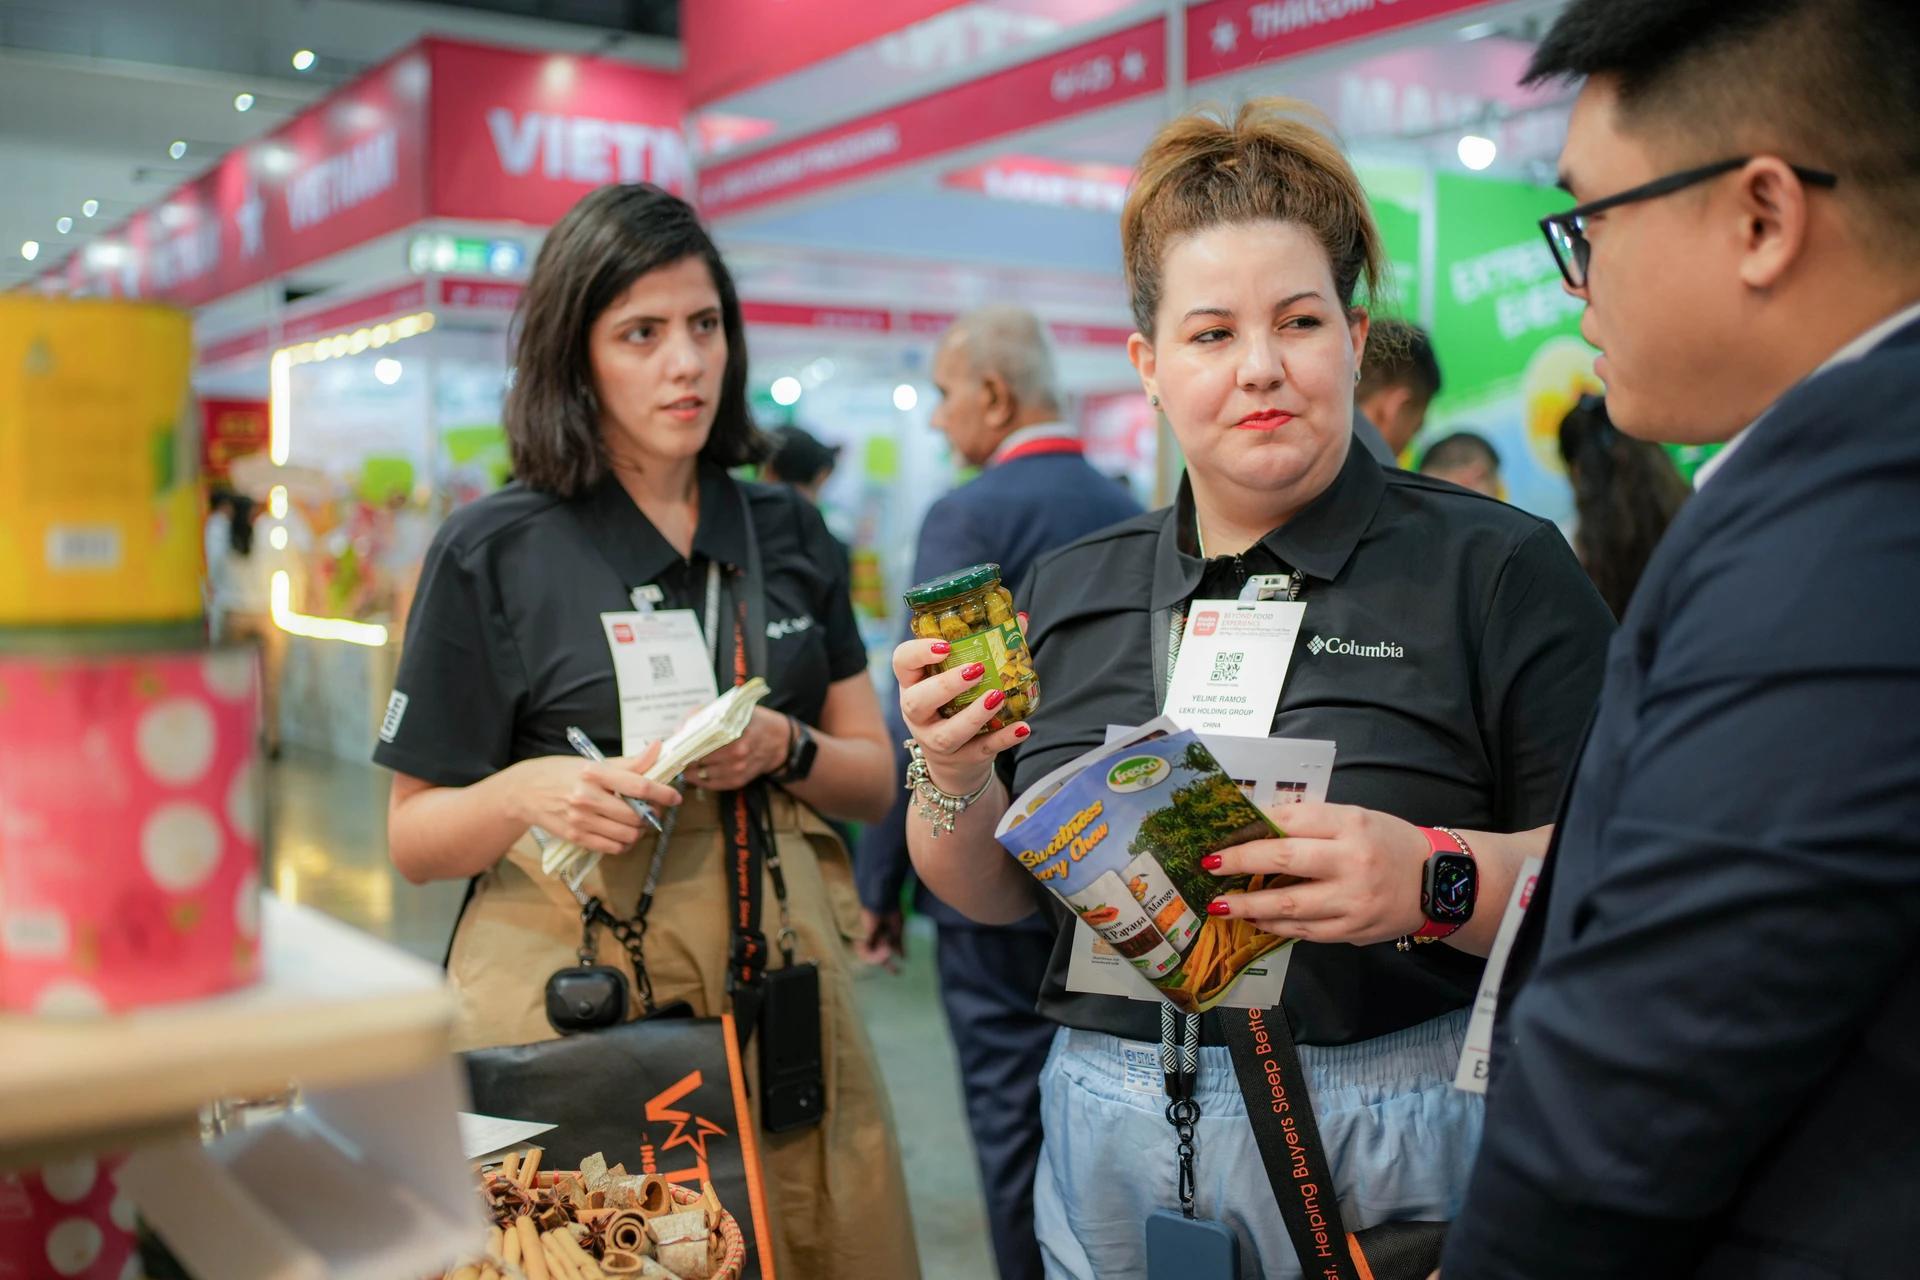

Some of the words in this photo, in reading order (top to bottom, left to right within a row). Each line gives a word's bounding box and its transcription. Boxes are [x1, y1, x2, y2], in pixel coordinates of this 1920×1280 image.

[1325, 637, 1404, 658] Columbia
[1192, 694, 1217, 702] YELINE
[1219, 695, 1247, 704] RAMOS
[1179, 706, 1196, 714] LEKE
[1197, 707, 1227, 716] HOLDING
[1228, 708, 1254, 716] GROUP
[1203, 721, 1221, 729] CHINA
[1147, 889, 1174, 914] Mango
[1110, 917, 1147, 940] Papaya
[1249, 1007, 1272, 1055] Bette
[1136, 1052, 1157, 1066] STYLE
[1264, 1059, 1289, 1113] Sleep
[1281, 1117, 1309, 1179] Buyers
[1301, 1183, 1332, 1257] Helping
